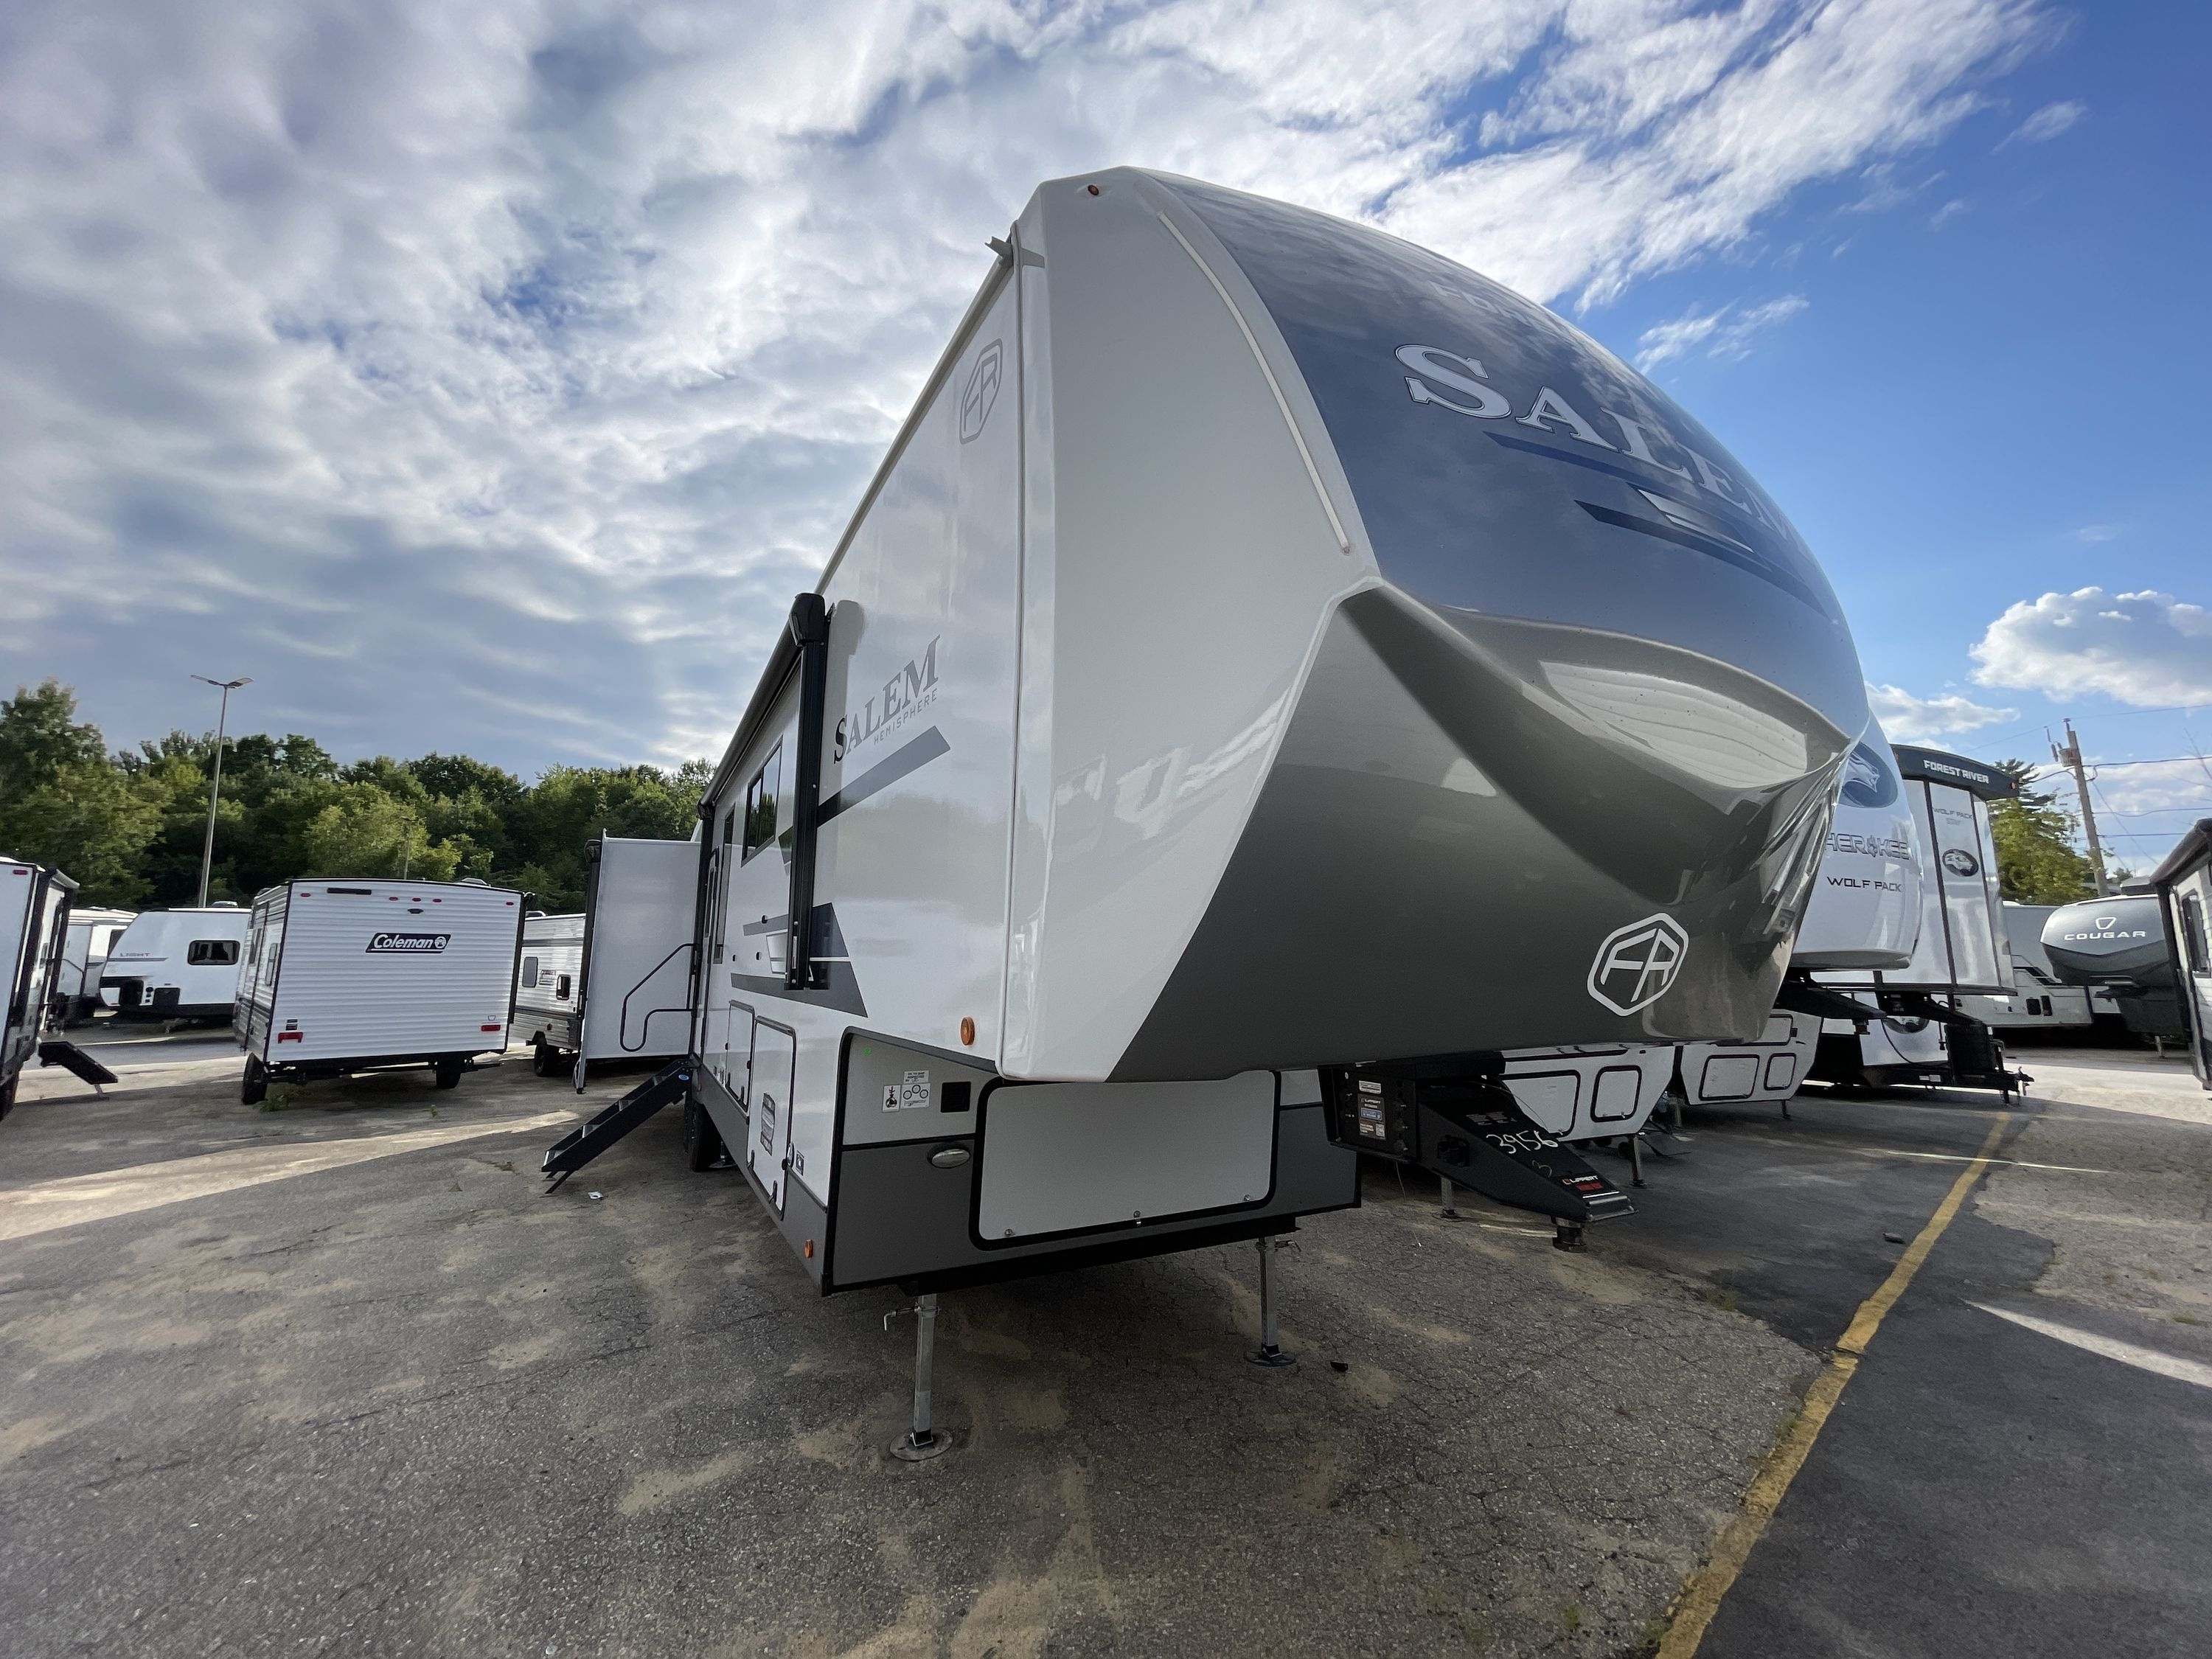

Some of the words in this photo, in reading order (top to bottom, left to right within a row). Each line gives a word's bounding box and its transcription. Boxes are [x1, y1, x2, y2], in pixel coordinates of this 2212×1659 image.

[834, 634, 940, 764] SALEM
[874, 688, 937, 745] HEMISPHERE
[1923, 759, 1962, 777] FOREST
[1963, 770, 1989, 784] RIVER
[1932, 807, 1955, 815] WOLF
[1956, 811, 1973, 820] PACK
[1826, 832, 1910, 860] HEROKEE
[1827, 876, 1871, 888] WOLF
[1875, 881, 1902, 893] PACK
[374, 933, 434, 949] Coleman
[2064, 931, 2146, 941] COUGAR
[1486, 1130, 1559, 1155] 3956
